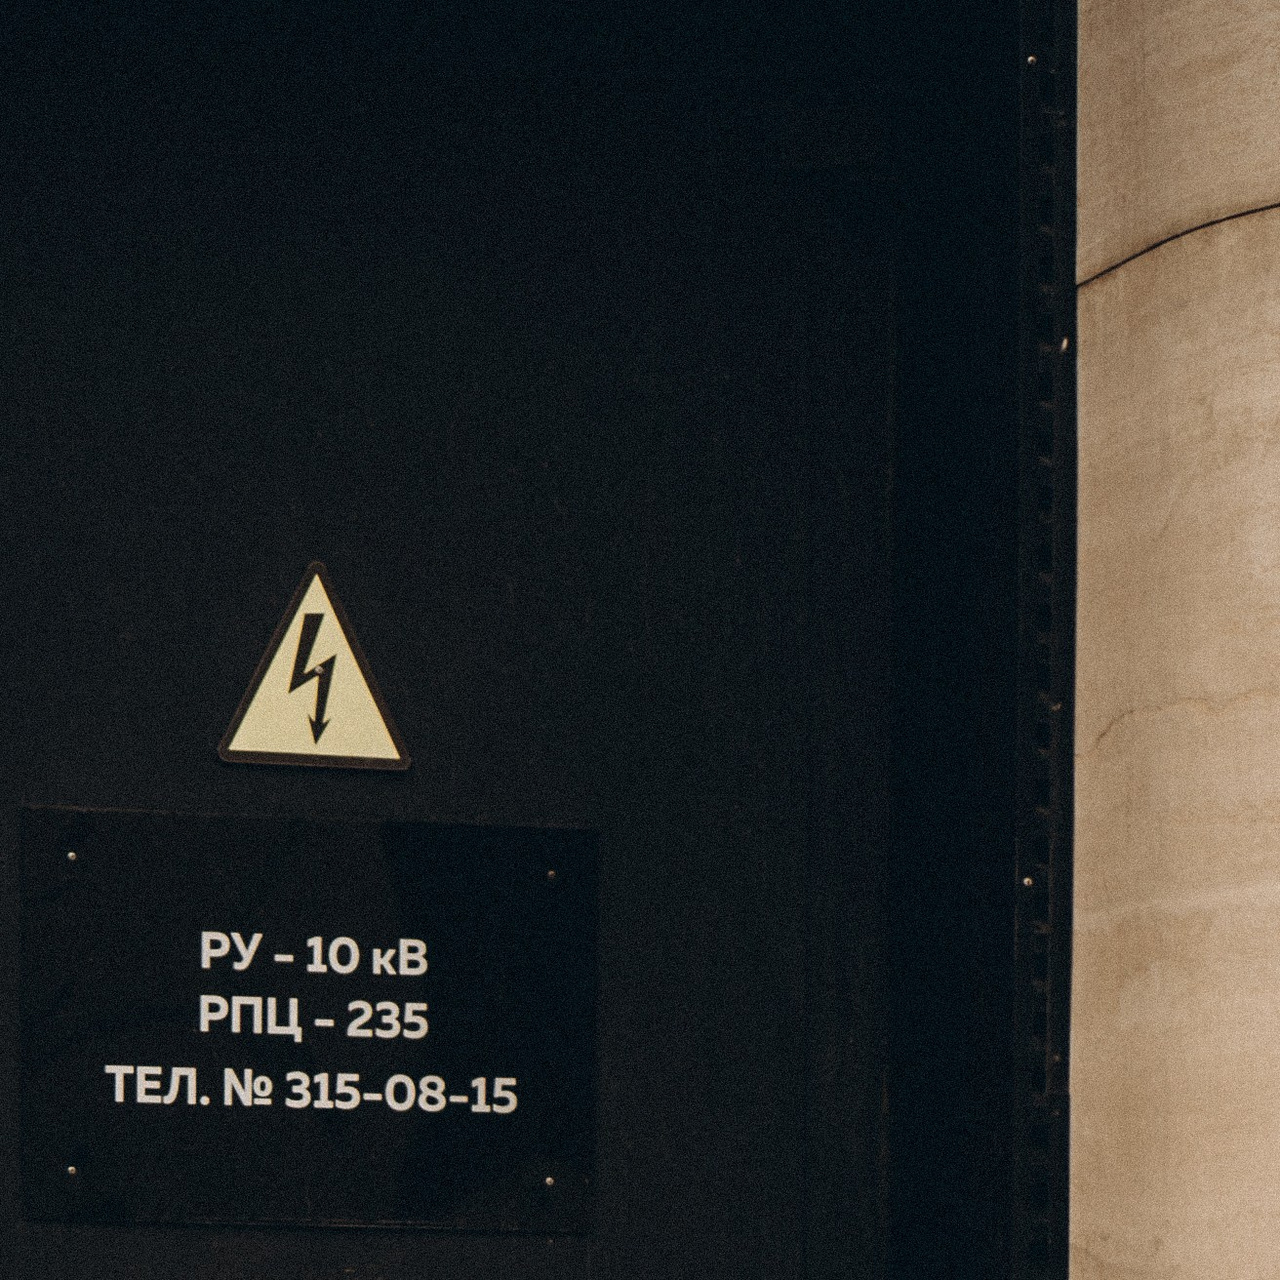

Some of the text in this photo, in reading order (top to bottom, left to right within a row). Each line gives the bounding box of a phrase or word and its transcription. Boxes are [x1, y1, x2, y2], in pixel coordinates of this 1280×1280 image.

[200, 931, 264, 971] РУ
[306, 936, 361, 975] 10
[372, 939, 428, 976] кВ
[199, 994, 303, 1043] РПЦ
[346, 999, 429, 1040] 235
[104, 1064, 518, 1114] ТЕЛ. № 315-08-15
